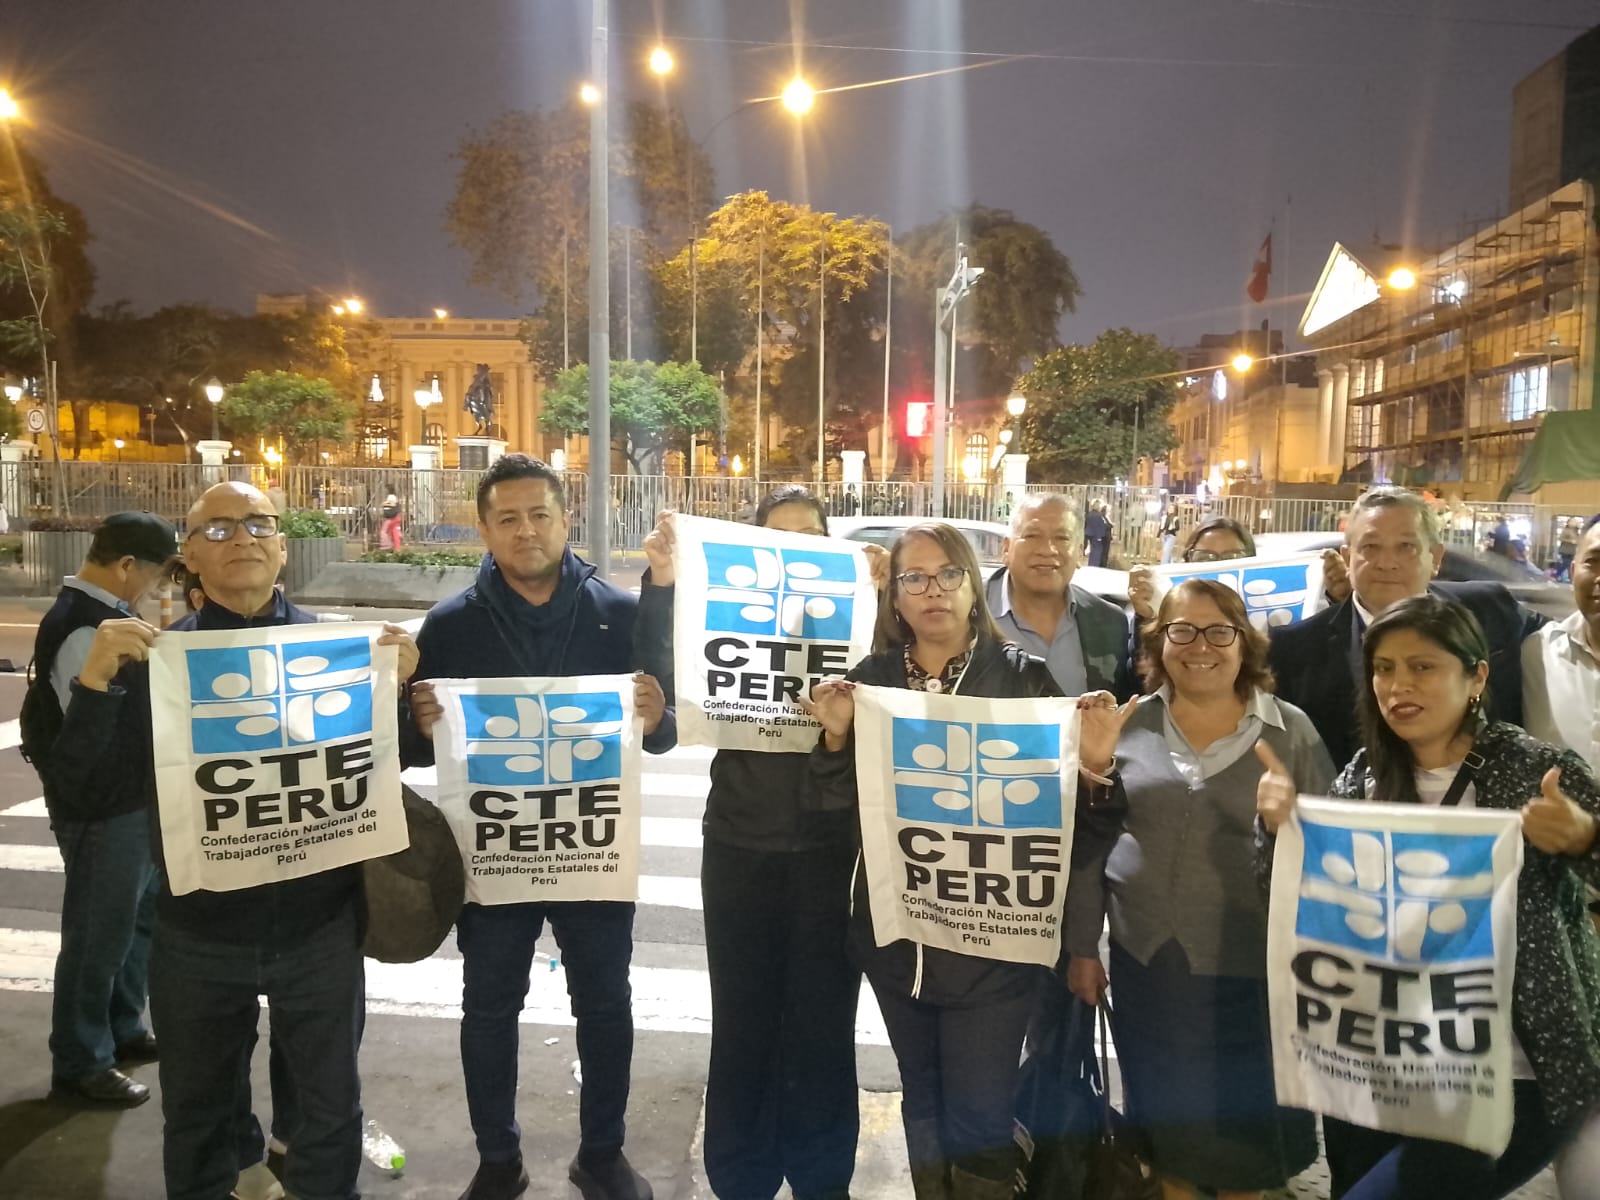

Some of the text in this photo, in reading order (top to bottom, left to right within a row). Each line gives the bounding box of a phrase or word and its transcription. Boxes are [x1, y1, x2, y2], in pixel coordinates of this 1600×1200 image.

[704, 637, 850, 674] CTE
[703, 699, 812, 716] Confederación Nacio
[705, 711, 823, 728] Trabajadores Estatales
[758, 726, 783, 738] Perú
[195, 738, 374, 795] CTE
[203, 774, 368, 832] PERÚ
[469, 784, 621, 820] CTE
[201, 808, 377, 847] Confederación Nacional de
[203, 821, 377, 861] Trabajadores Estatales del
[476, 815, 616, 852] PERÚ
[277, 851, 307, 866] Perú
[471, 850, 620, 865] Confederación Nacional de
[897, 827, 1061, 872] CTE
[472, 863, 618, 876] Trabajadores Estatales del
[531, 876, 558, 886] Perú
[904, 861, 1055, 908] PERÚ
[901, 893, 1058, 925] Conederación Nacional de
[962, 933, 991, 947] Perú
[979, 922, 1038, 937] Estatales
[1040, 927, 1055, 940] del
[1290, 950, 1498, 1013] CTE
[1290, 1034, 1397, 1076] federación
[1297, 1049, 1388, 1090] bajadores
